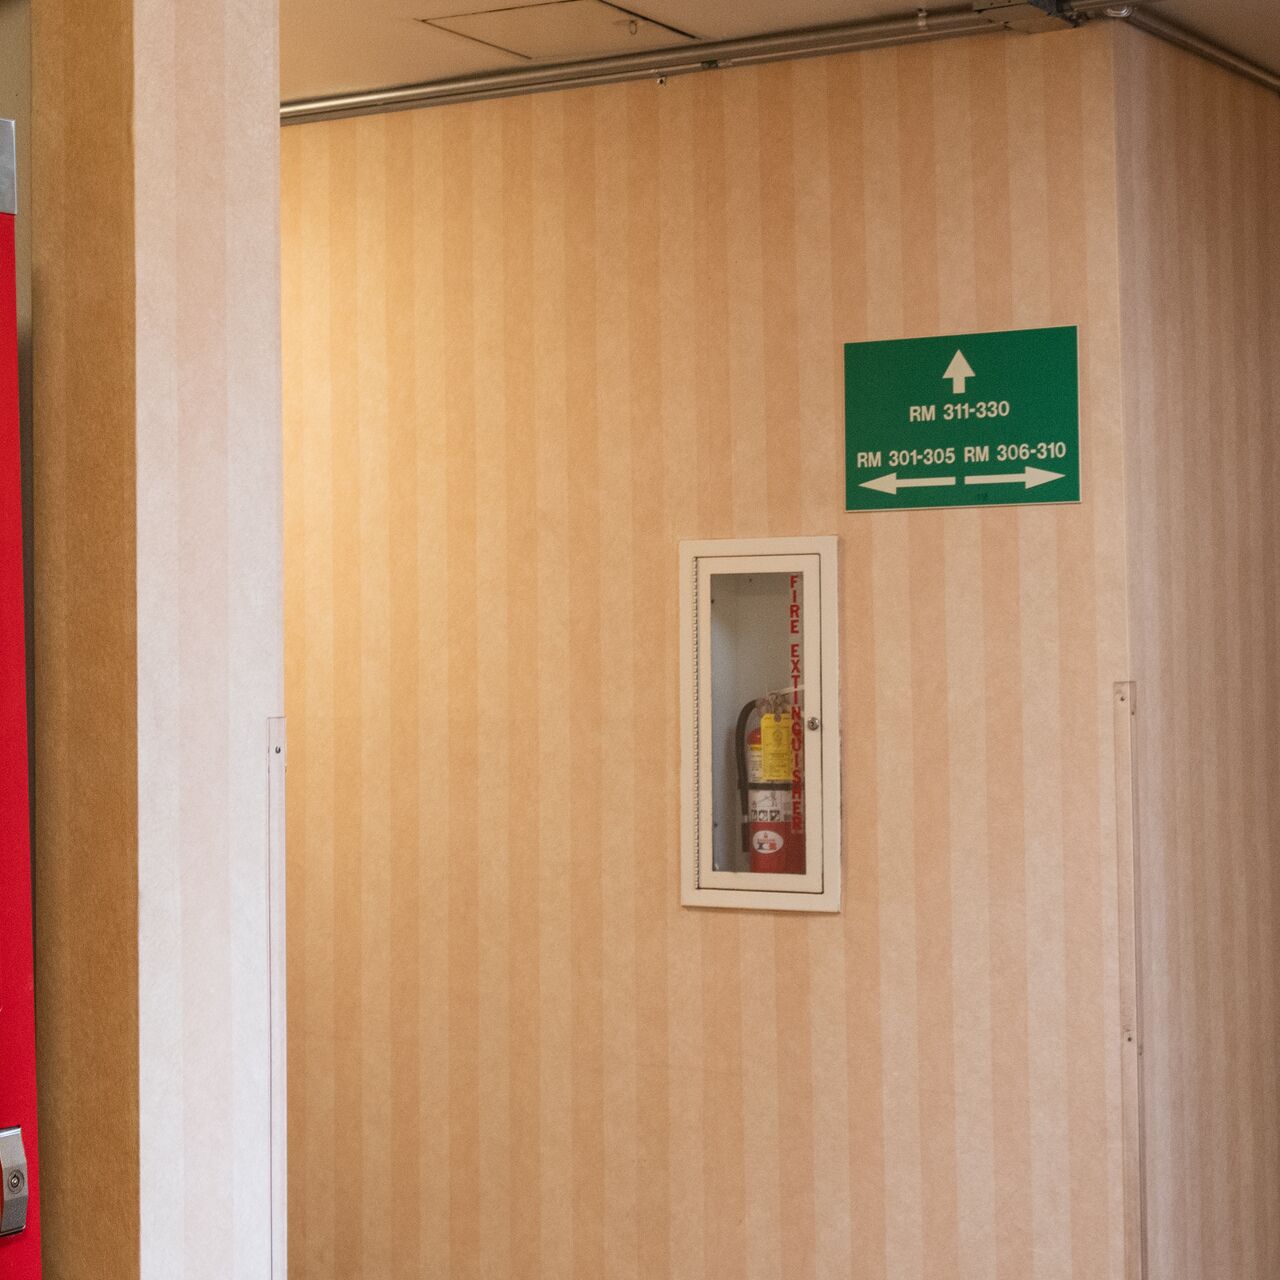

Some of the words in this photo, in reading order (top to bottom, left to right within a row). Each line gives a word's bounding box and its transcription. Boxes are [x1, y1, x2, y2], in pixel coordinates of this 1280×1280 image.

[909, 405, 936, 422] RM
[943, 400, 1010, 420] 311-330
[856, 452, 882, 468] RM
[888, 448, 956, 467] 301-305
[964, 445, 989, 463] RM
[996, 441, 1067, 462] 306-310
[789, 575, 800, 634] FIRE
[790, 644, 802, 831] EXTINGUISHER
